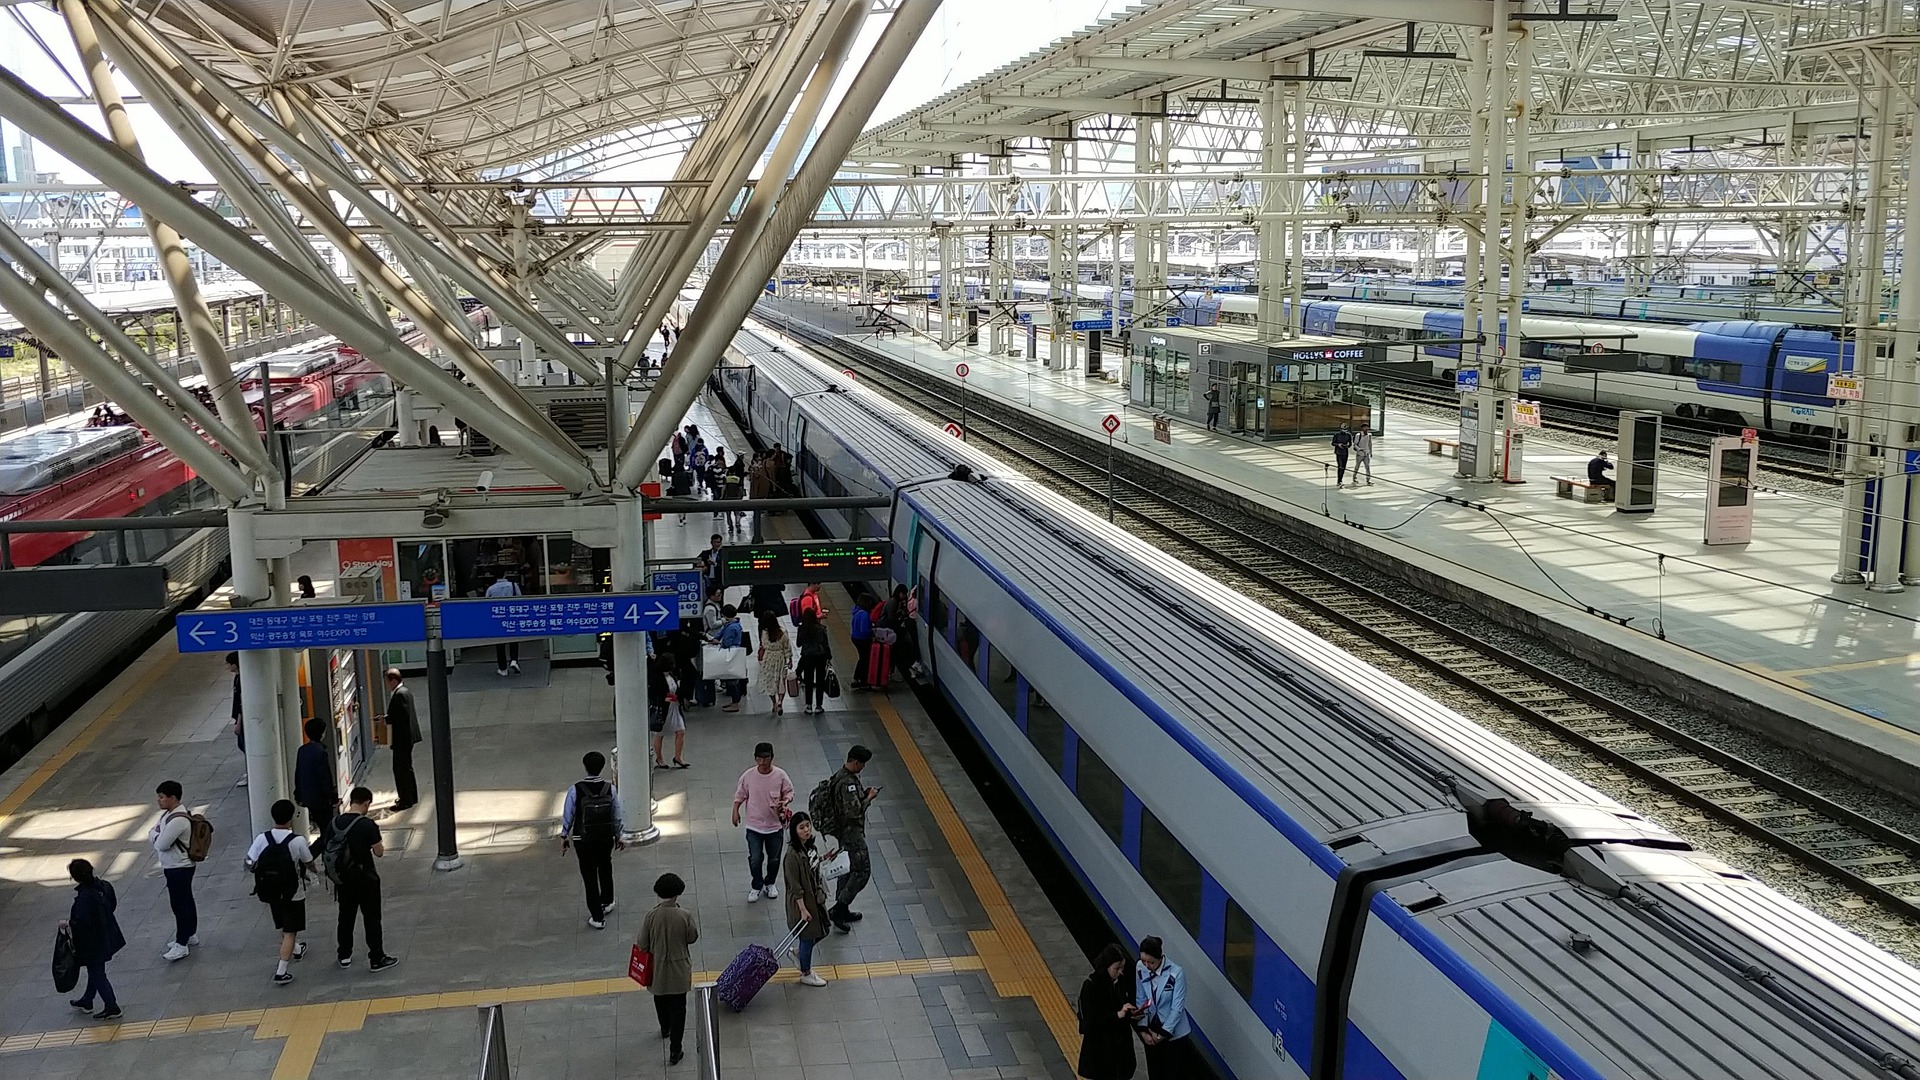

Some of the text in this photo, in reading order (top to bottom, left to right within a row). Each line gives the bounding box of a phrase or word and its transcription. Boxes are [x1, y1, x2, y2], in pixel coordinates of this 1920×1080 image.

[1293, 350, 1364, 360] HOLLYS COFFEE
[623, 603, 640, 625] 4
[223, 621, 239, 643] 3
